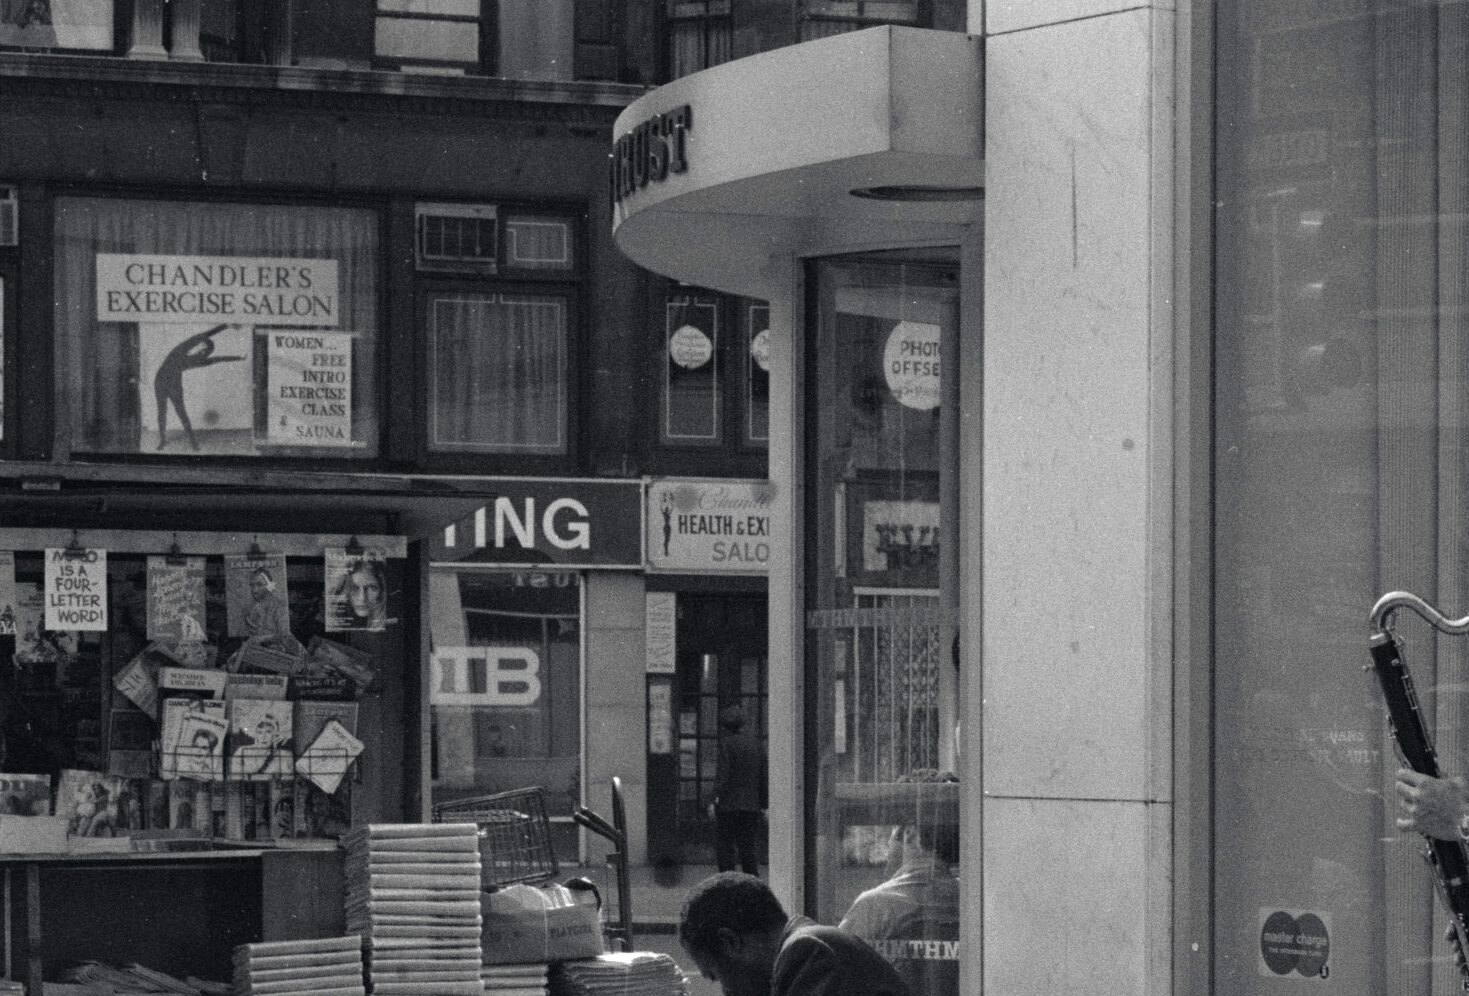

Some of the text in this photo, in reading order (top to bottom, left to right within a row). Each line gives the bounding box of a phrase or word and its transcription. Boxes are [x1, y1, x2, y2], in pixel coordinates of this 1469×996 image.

[125, 262, 313, 291] CHANDLER'S
[107, 290, 333, 317] EXERCISE SALON
[312, 353, 346, 368] FREE
[303, 369, 346, 384] INTRO
[280, 385, 346, 401] EXERCISE
[302, 402, 346, 418] CLASS
[280, 415, 346, 440] & SAUNA
[678, 515, 770, 536] HEALTH & EX
[61, 565, 88, 576] IS A
[55, 577, 99, 592] FOUR-
[51, 593, 101, 607] LETTER
[58, 609, 104, 624] WORD!
[1263, 931, 1327, 948] master charge
